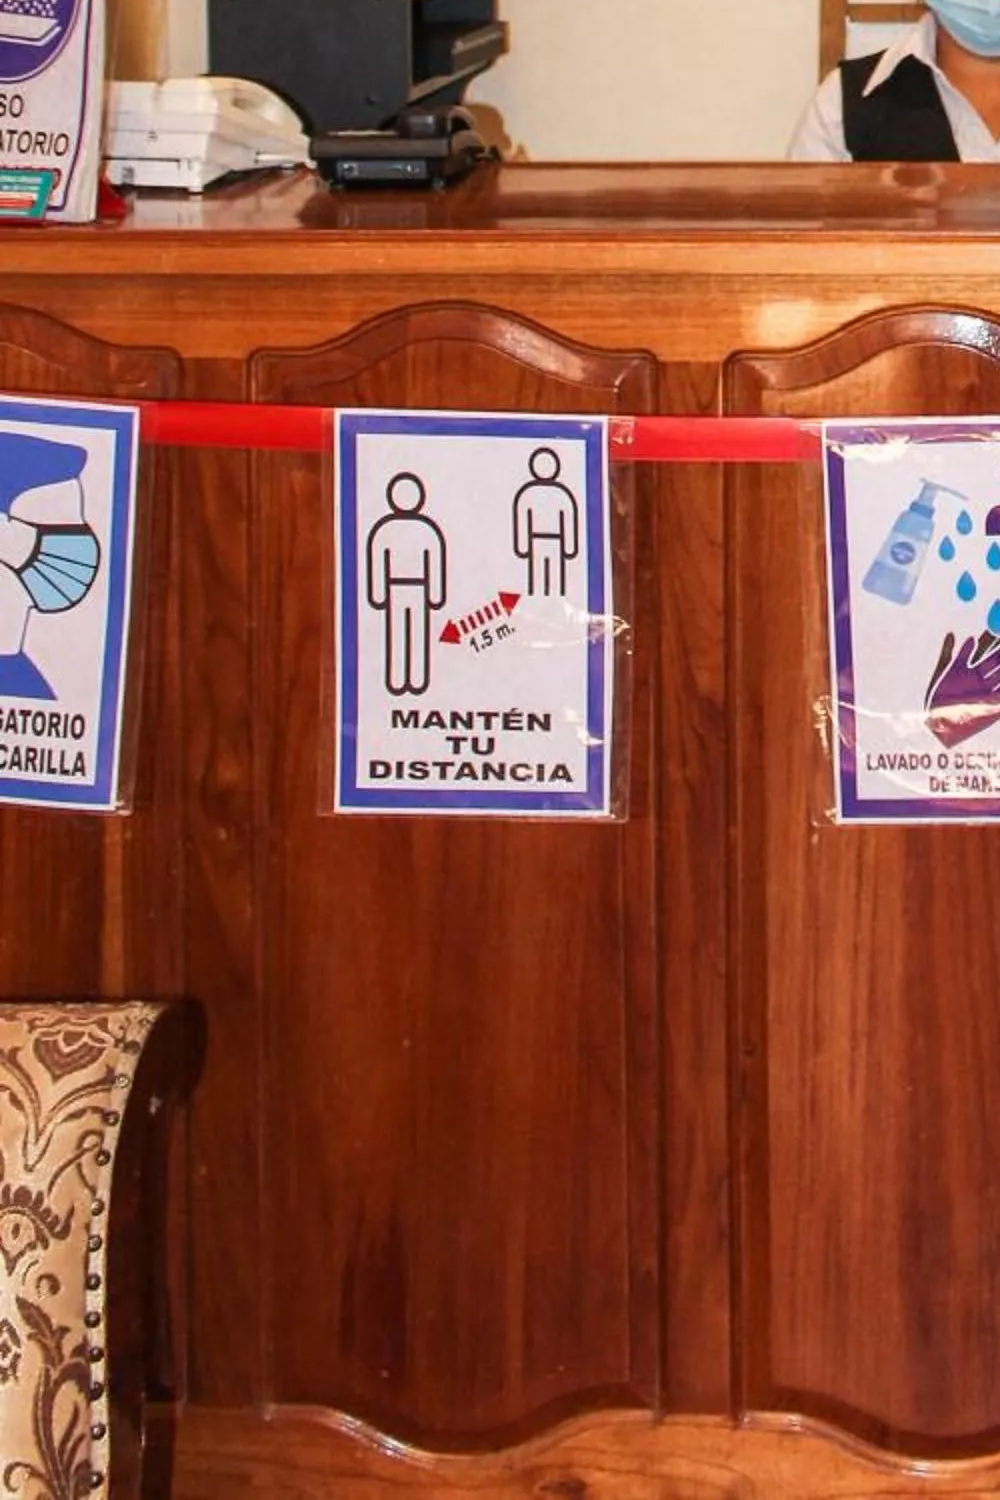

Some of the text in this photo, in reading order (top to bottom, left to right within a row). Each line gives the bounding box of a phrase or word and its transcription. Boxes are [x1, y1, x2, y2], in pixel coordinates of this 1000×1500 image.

[470, 628, 494, 653] 1.5
[0, 707, 86, 741] ATORIO
[391, 708, 552, 732] MANTÉN
[446, 736, 495, 756] TU
[368, 760, 574, 783] DISTANCIA
[866, 753, 932, 772] LAVADO
[937, 753, 949, 770] O
